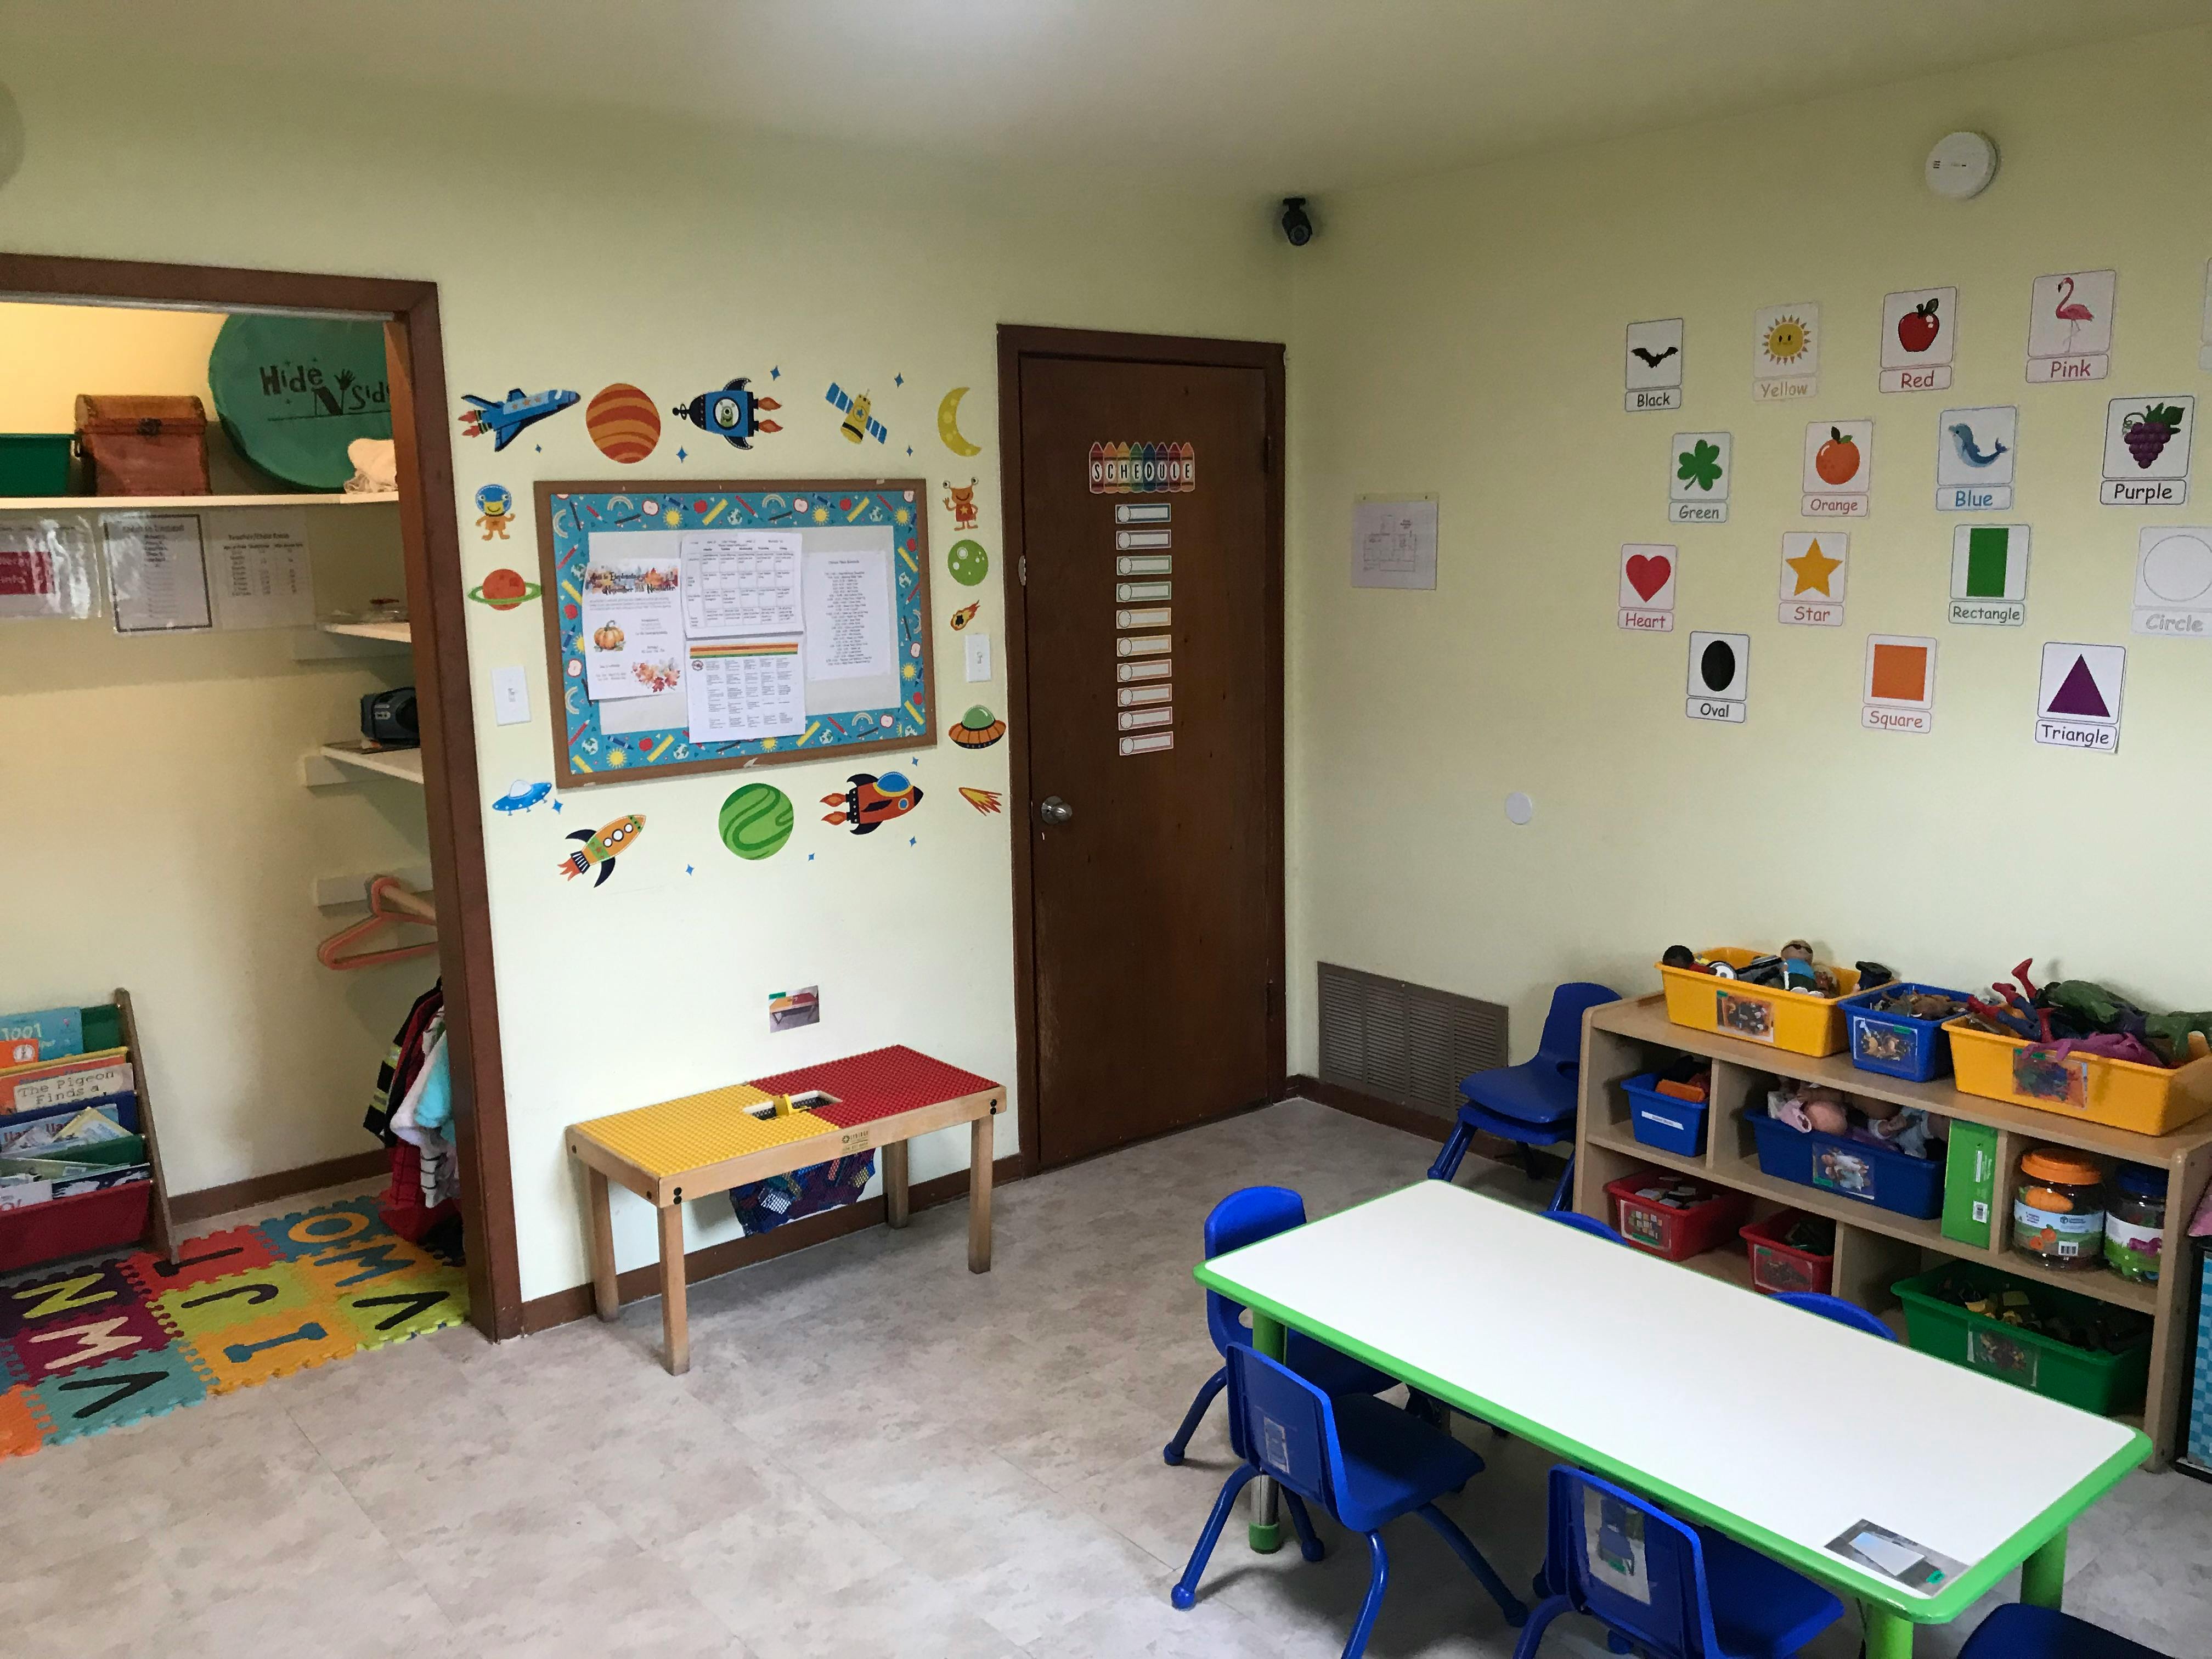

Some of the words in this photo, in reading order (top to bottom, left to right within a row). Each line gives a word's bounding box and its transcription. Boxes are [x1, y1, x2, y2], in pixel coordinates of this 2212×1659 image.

[2050, 360, 2091, 378] Pink
[259, 365, 324, 396] Hide
[1900, 370, 1935, 388] Red
[1760, 381, 1808, 398] Yellow
[1637, 392, 1671, 408] Black
[1094, 464, 1190, 479] SCHEDULE
[1955, 490, 1993, 507] Blue
[2114, 483, 2172, 504] Purple
[1679, 505, 1719, 519] Green
[1810, 499, 1858, 515] Orange
[1625, 612, 1666, 629] Heart
[1794, 606, 1831, 622] Star
[1953, 606, 2020, 623] Rectangle
[2146, 613, 2204, 632] Circle
[1700, 702, 1729, 718] Oval
[1869, 710, 1923, 729] Square
[2041, 724, 2109, 747] Triangle
[1, 1023, 42, 1041] 1001
[18, 1084, 49, 1097] The
[57, 1070, 115, 1089] Pigeon
[35, 1088, 84, 1105] Finds
